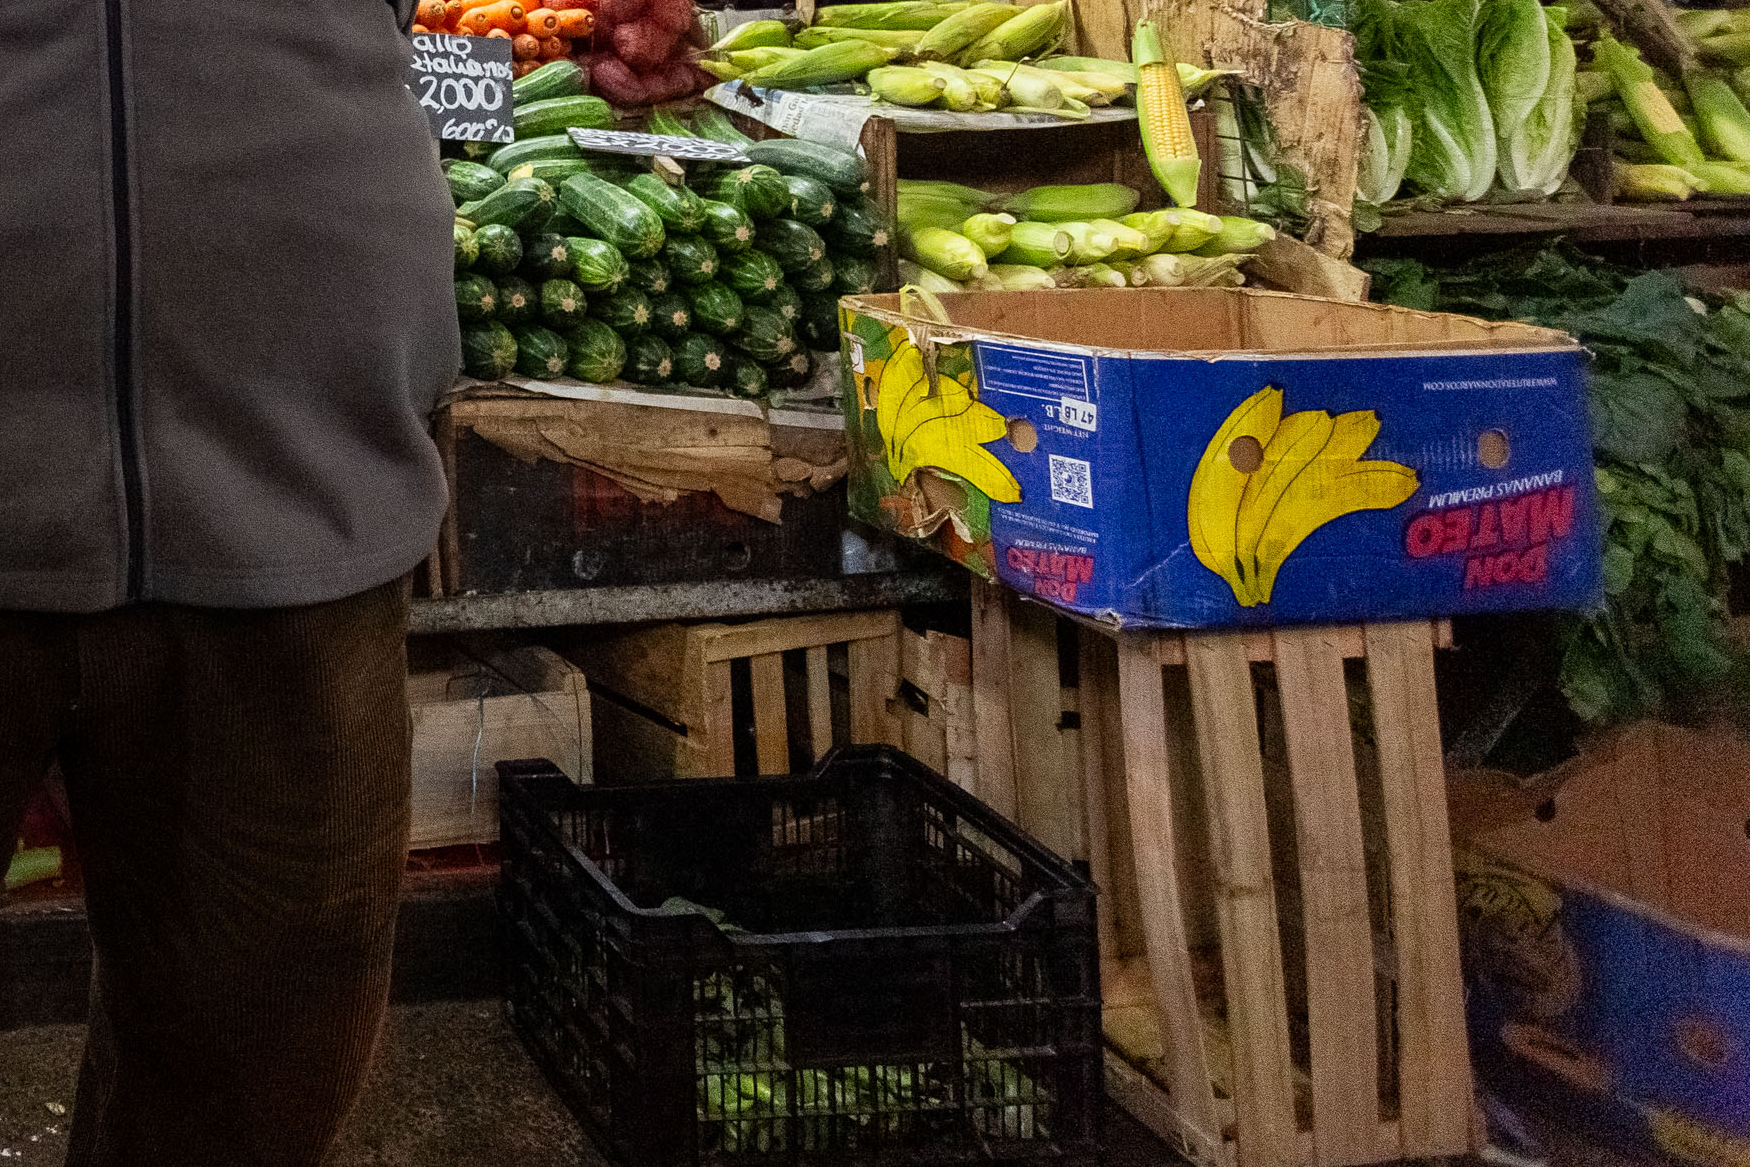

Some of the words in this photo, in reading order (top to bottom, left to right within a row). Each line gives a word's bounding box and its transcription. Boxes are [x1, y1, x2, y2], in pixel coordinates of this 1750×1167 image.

[1064, 406, 1078, 421] LB
[1080, 410, 1094, 425] 47
[1496, 468, 1563, 495] BANANAS
[1428, 484, 1494, 508] PREMIUM
[1406, 487, 1574, 558] MATEO
[1006, 546, 1094, 584] MATEO
[1464, 545, 1547, 590] DON
[1034, 576, 1077, 602] DON
